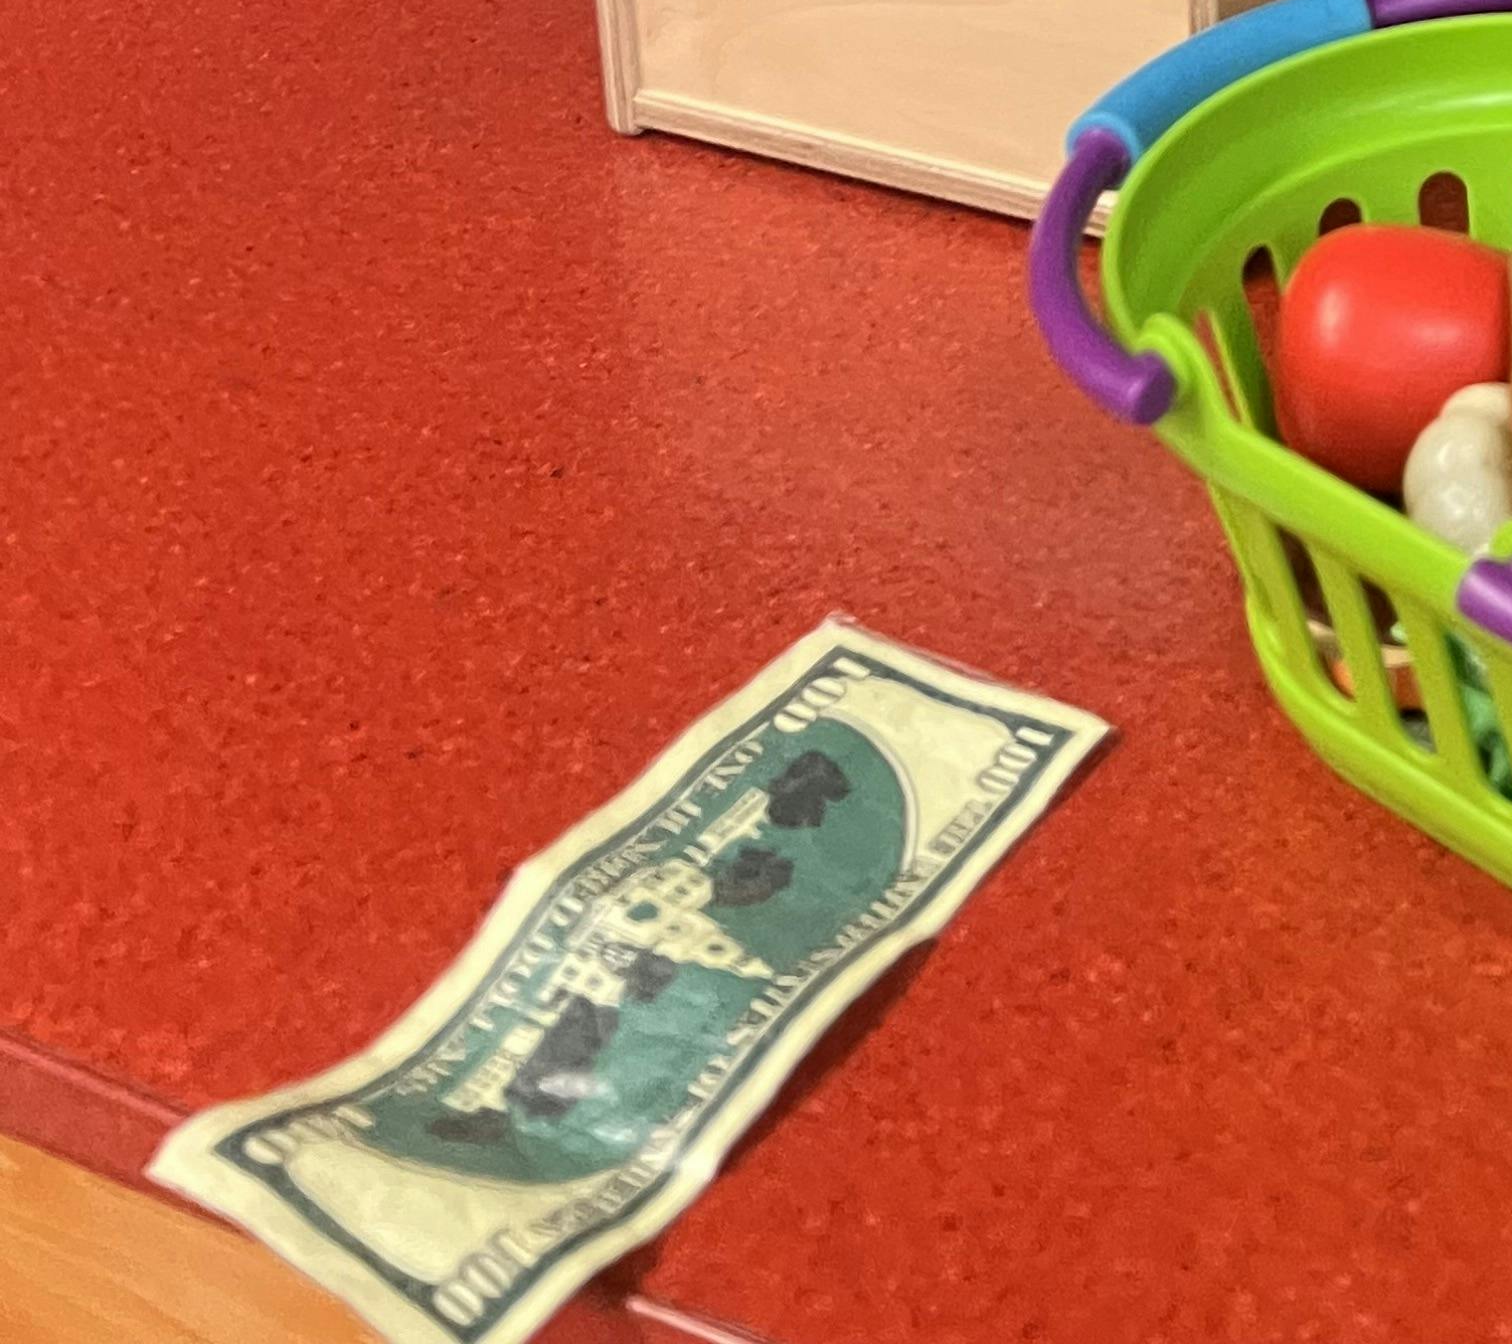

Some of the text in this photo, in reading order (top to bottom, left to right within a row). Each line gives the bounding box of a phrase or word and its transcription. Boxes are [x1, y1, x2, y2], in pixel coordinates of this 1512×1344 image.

[772, 656, 872, 734] 100
[977, 725, 1055, 795] 100
[432, 1224, 540, 1328] 100
